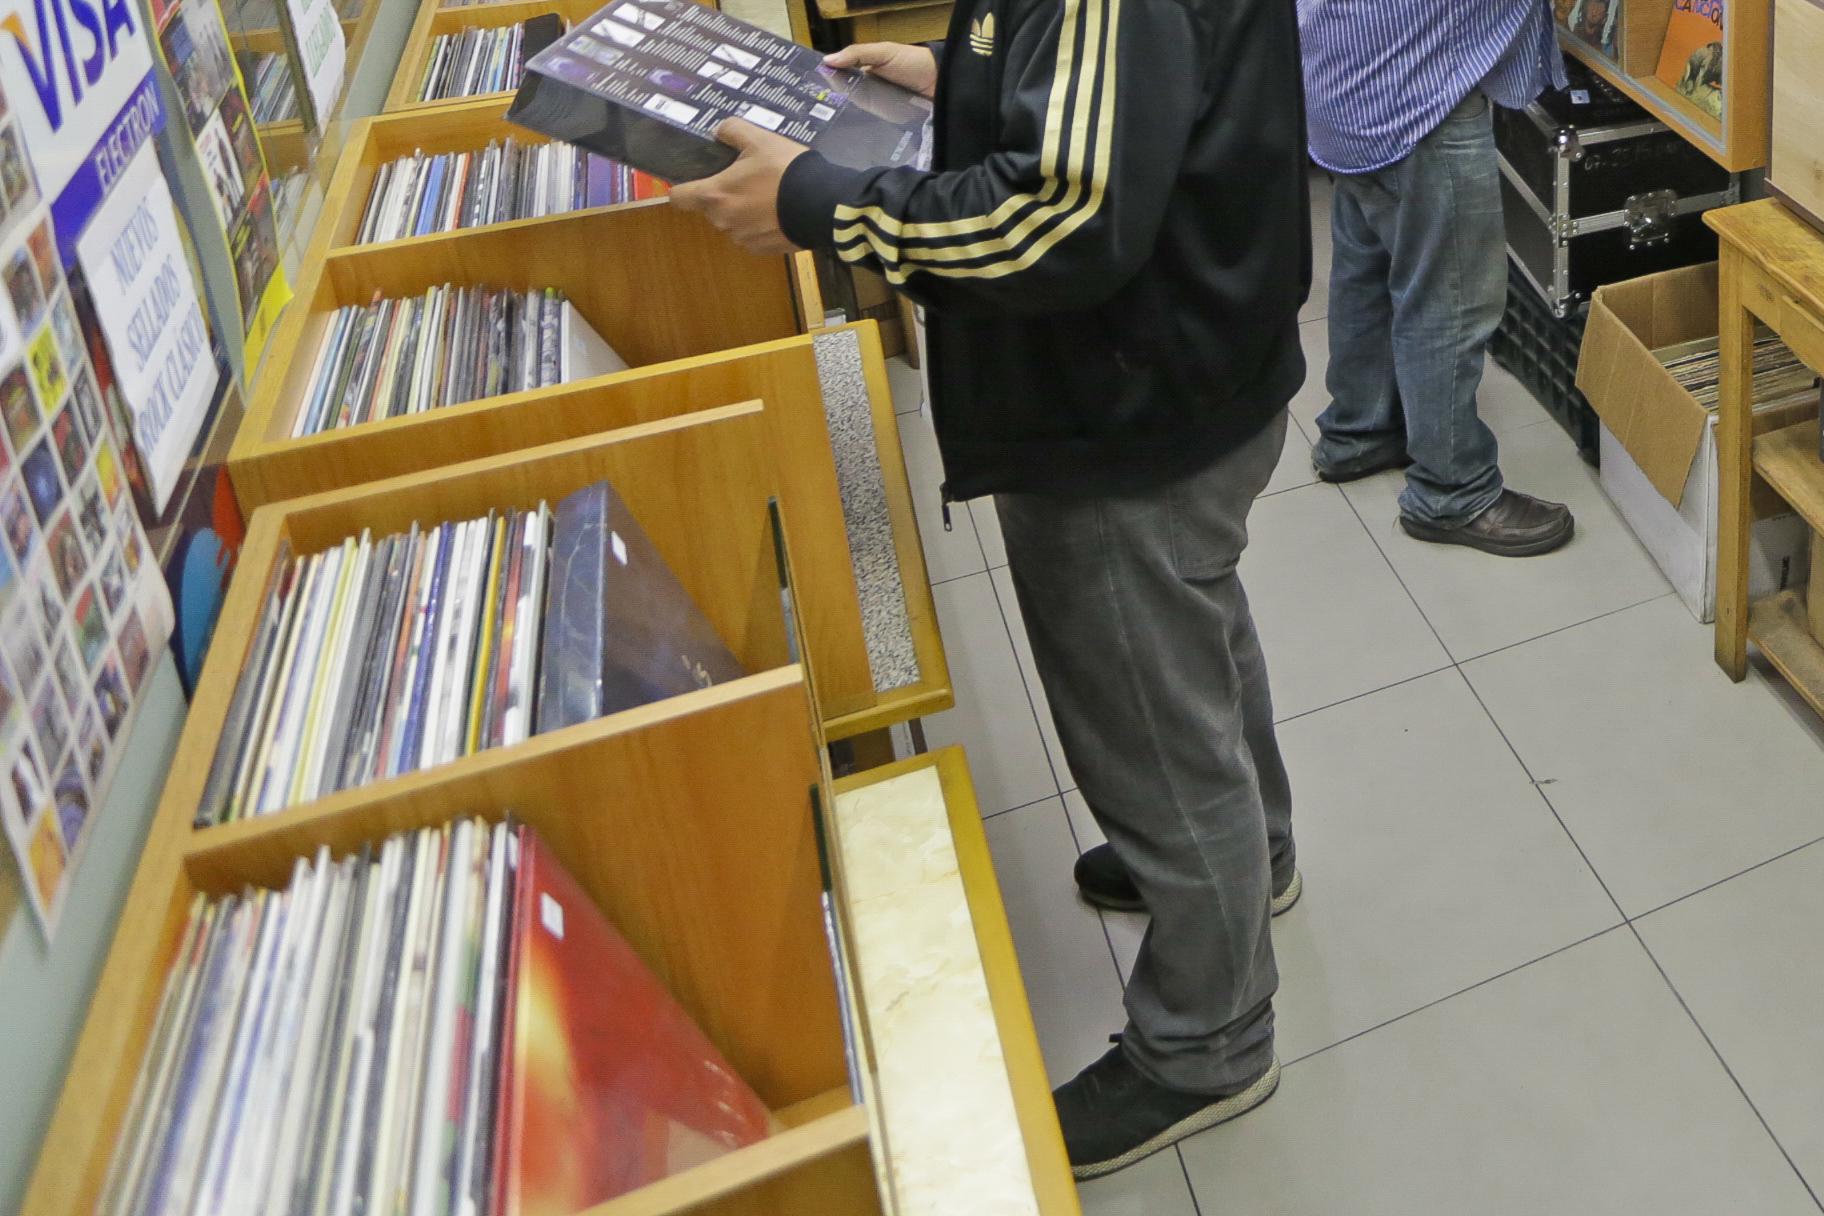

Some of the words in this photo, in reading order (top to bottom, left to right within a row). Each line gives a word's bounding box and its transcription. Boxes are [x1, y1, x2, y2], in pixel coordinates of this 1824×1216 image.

[97, 79, 162, 193] ELECTRON
[110, 195, 160, 295] NUEVOS
[127, 253, 182, 373] SELLADOS
[139, 370, 174, 458] ROCK
